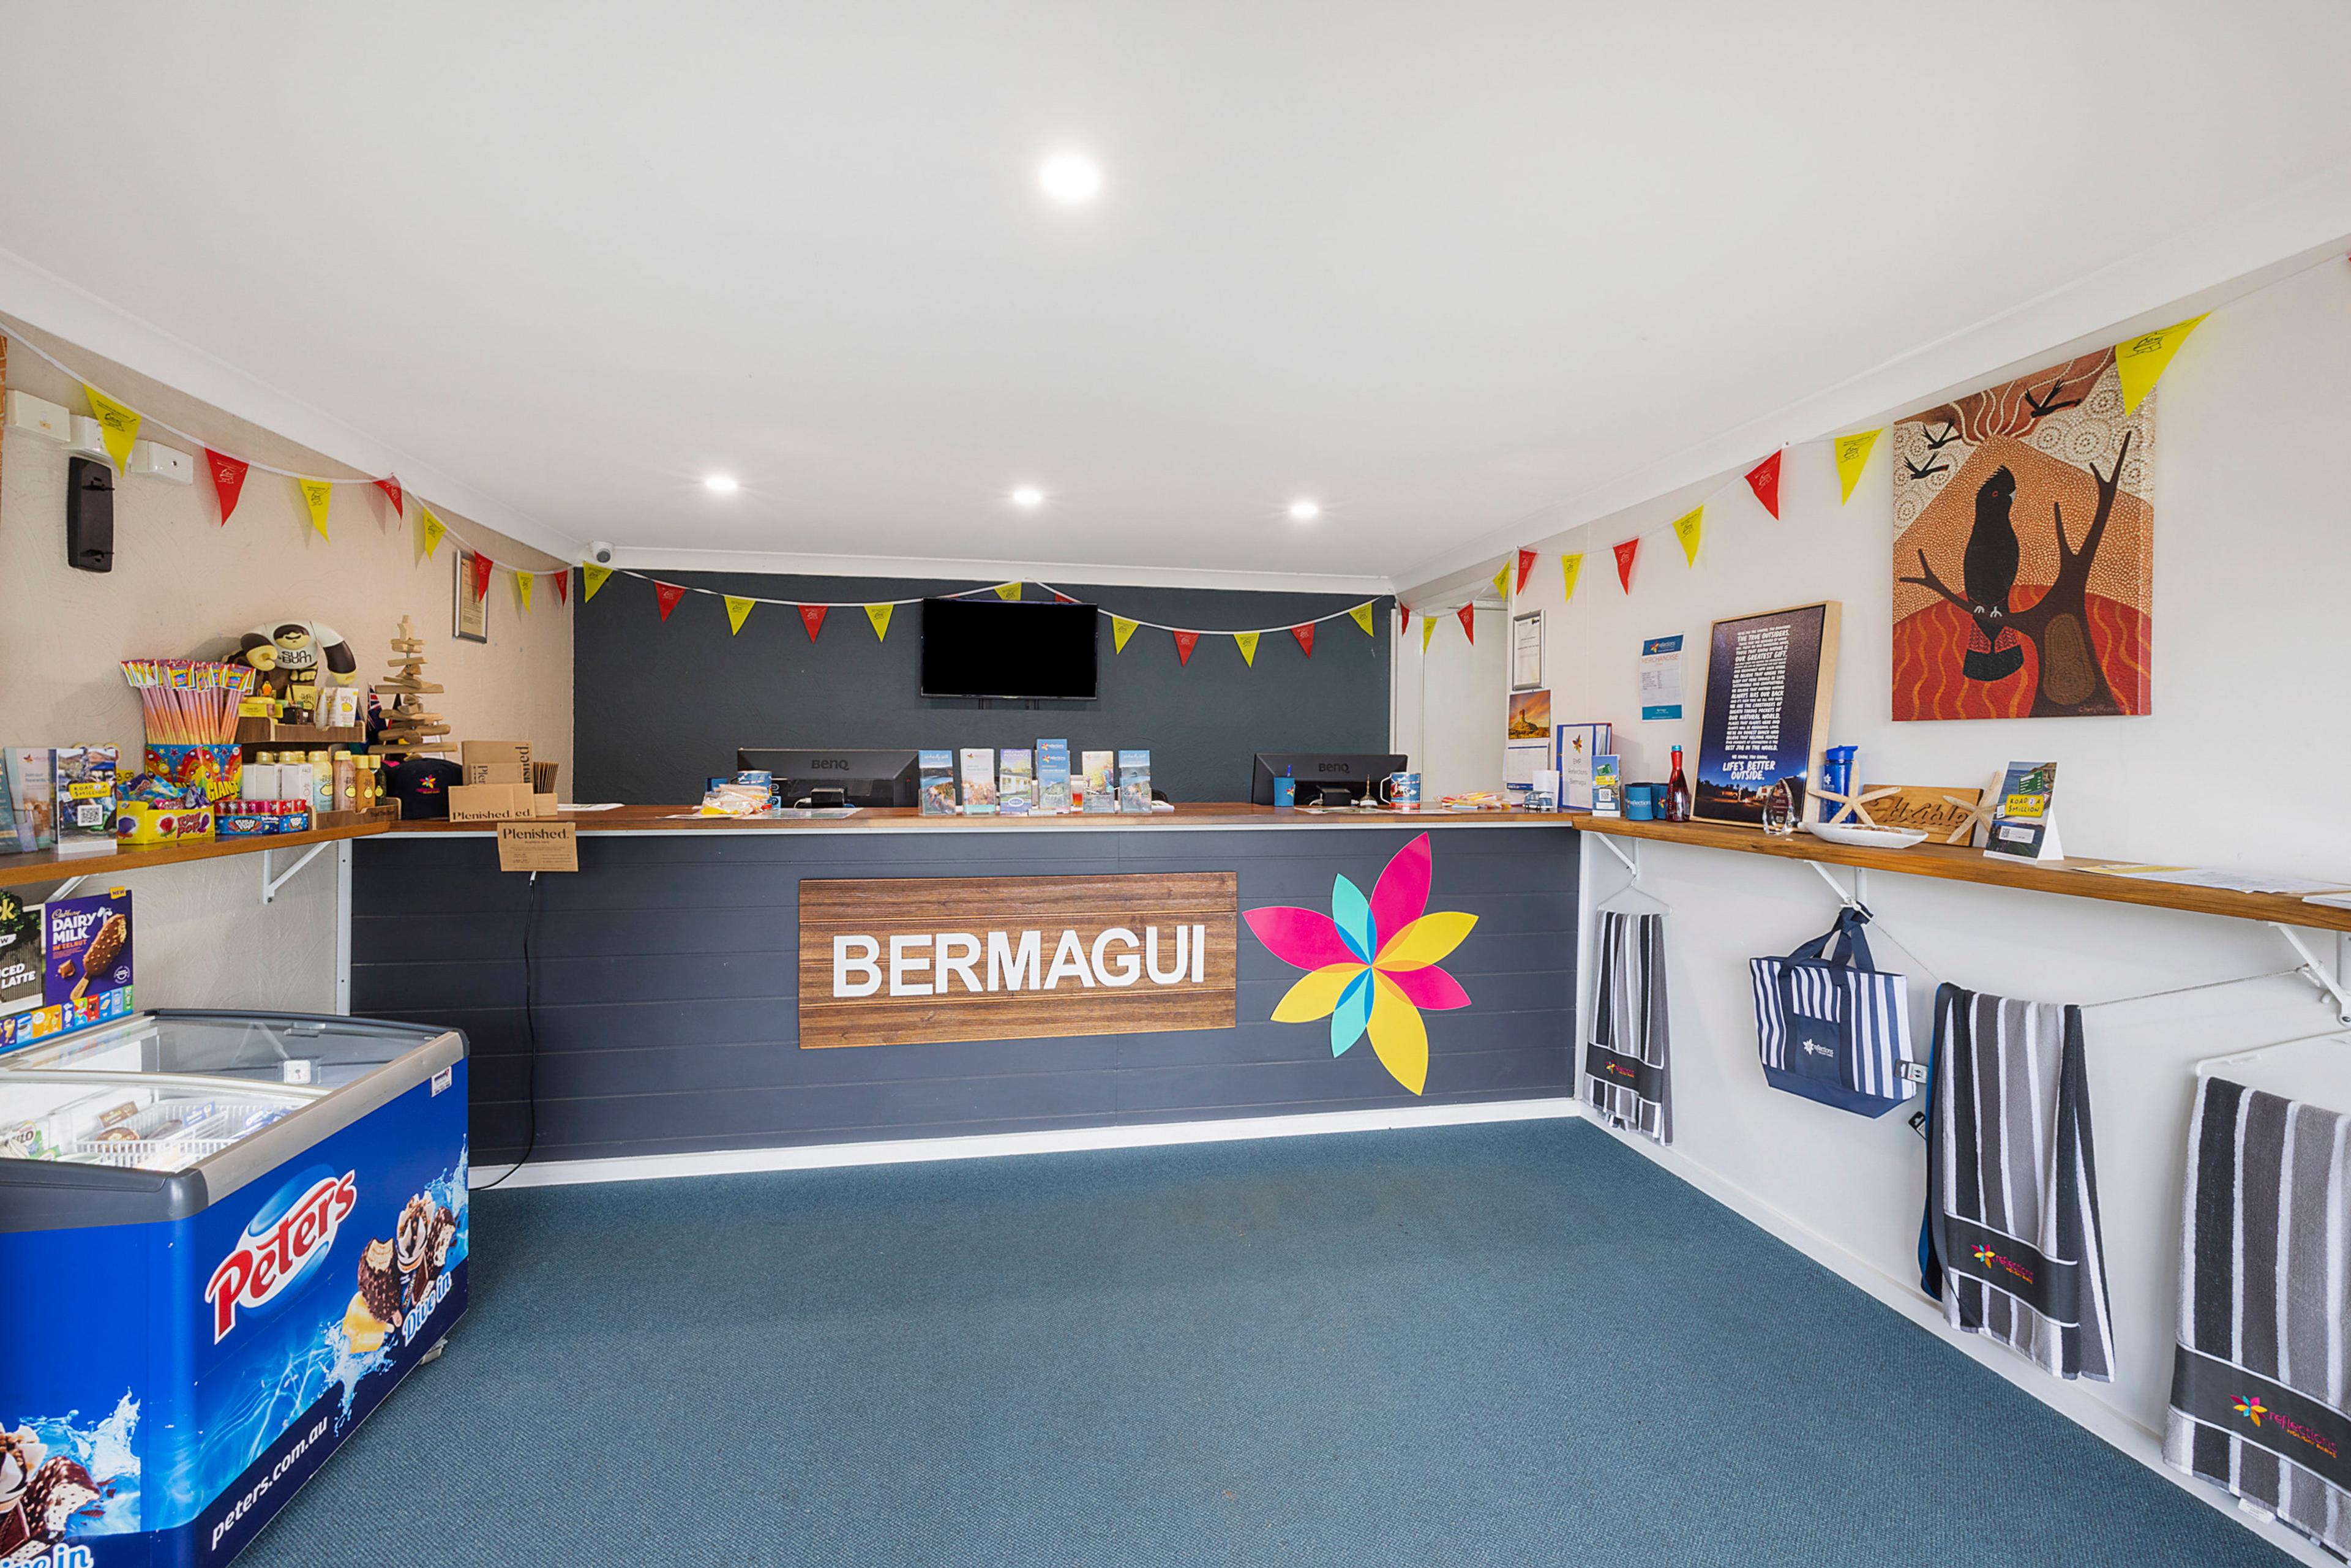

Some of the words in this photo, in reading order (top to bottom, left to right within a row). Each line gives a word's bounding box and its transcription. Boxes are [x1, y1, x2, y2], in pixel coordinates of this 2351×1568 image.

[1722, 761, 1745, 771] LIFE'S
[1746, 760, 1776, 771] BETTER
[1731, 771, 1765, 781] OUTSIDE.
[206, 781, 239, 801] GIANT
[453, 811, 512, 820] Plenished.
[503, 828, 569, 839] Plenished.
[51, 909, 81, 920] Cadbury
[53, 912, 97, 932] DAIRY
[53, 927, 91, 945] MILK
[833, 925, 1205, 997] BERMAGUI
[0, 963, 25, 978] CED
[1, 971, 36, 989] LATTE
[207, 1172, 355, 1341] Peters
[403, 1290, 436, 1346] Dive
[437, 1272, 452, 1303] in
[2269, 1411, 2338, 1454] reflections
[211, 1416, 328, 1551] peters.com.au
